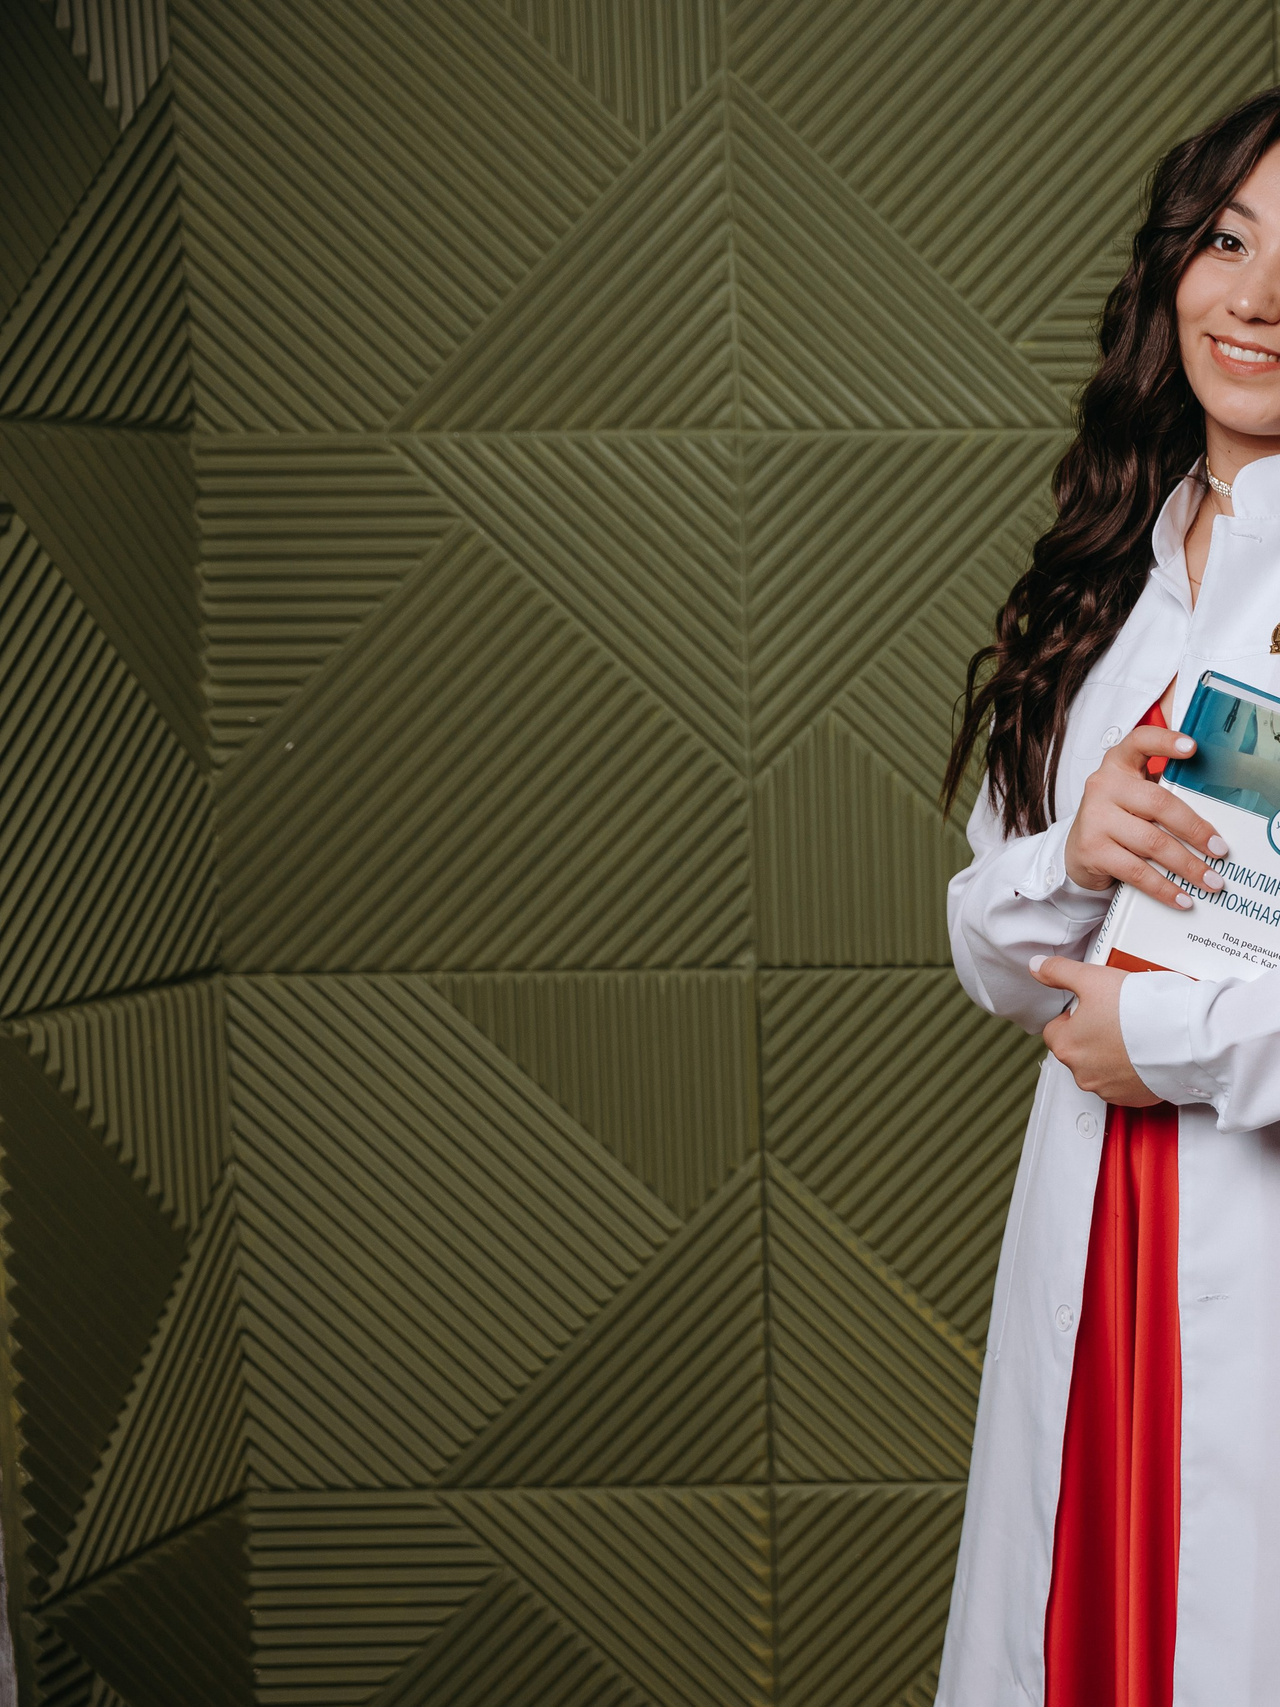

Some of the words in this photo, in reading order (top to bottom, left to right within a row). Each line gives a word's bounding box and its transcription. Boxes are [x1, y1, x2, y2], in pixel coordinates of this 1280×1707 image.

[1187, 932, 1241, 957] профессора
[1243, 953, 1259, 964] А.С.
[1222, 933, 1240, 946] Под
